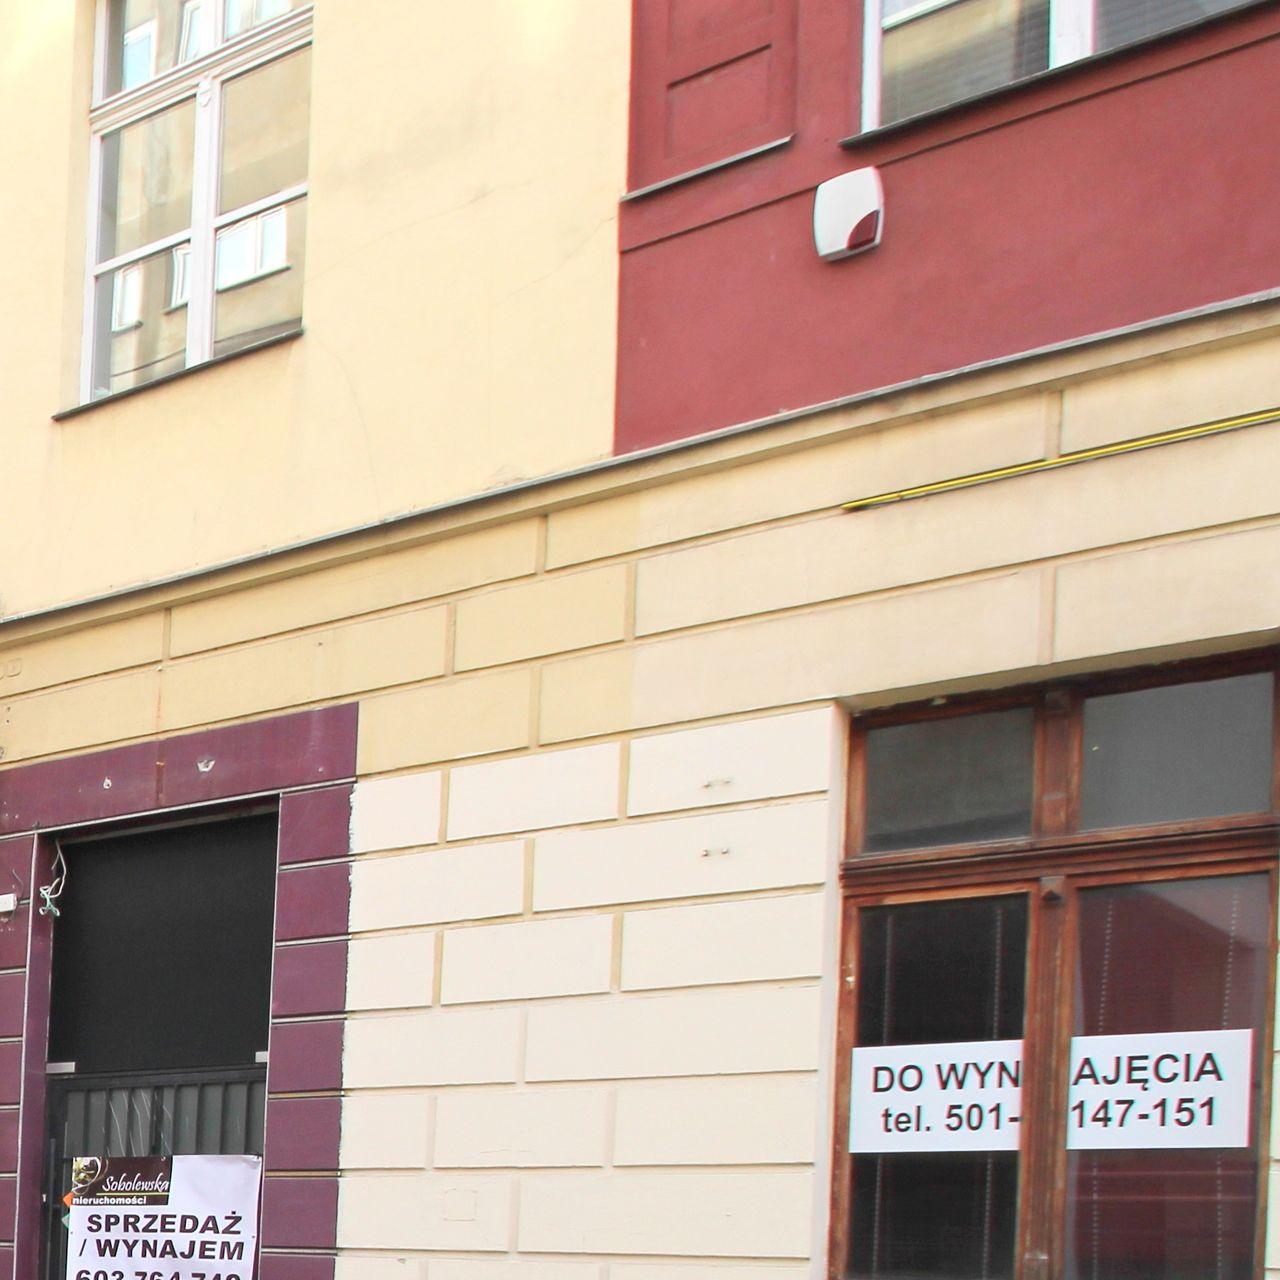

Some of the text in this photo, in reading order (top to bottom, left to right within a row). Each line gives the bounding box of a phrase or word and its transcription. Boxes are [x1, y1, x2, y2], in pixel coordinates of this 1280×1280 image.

[872, 1064, 923, 1093] DO
[881, 1106, 931, 1133] tel.
[101, 1172, 170, 1192] Sobolewska
[72, 1196, 147, 1205] nieruchomości
[87, 1211, 243, 1235] SPRZEDAŻ
[95, 1238, 245, 1260] WYNAJEM
